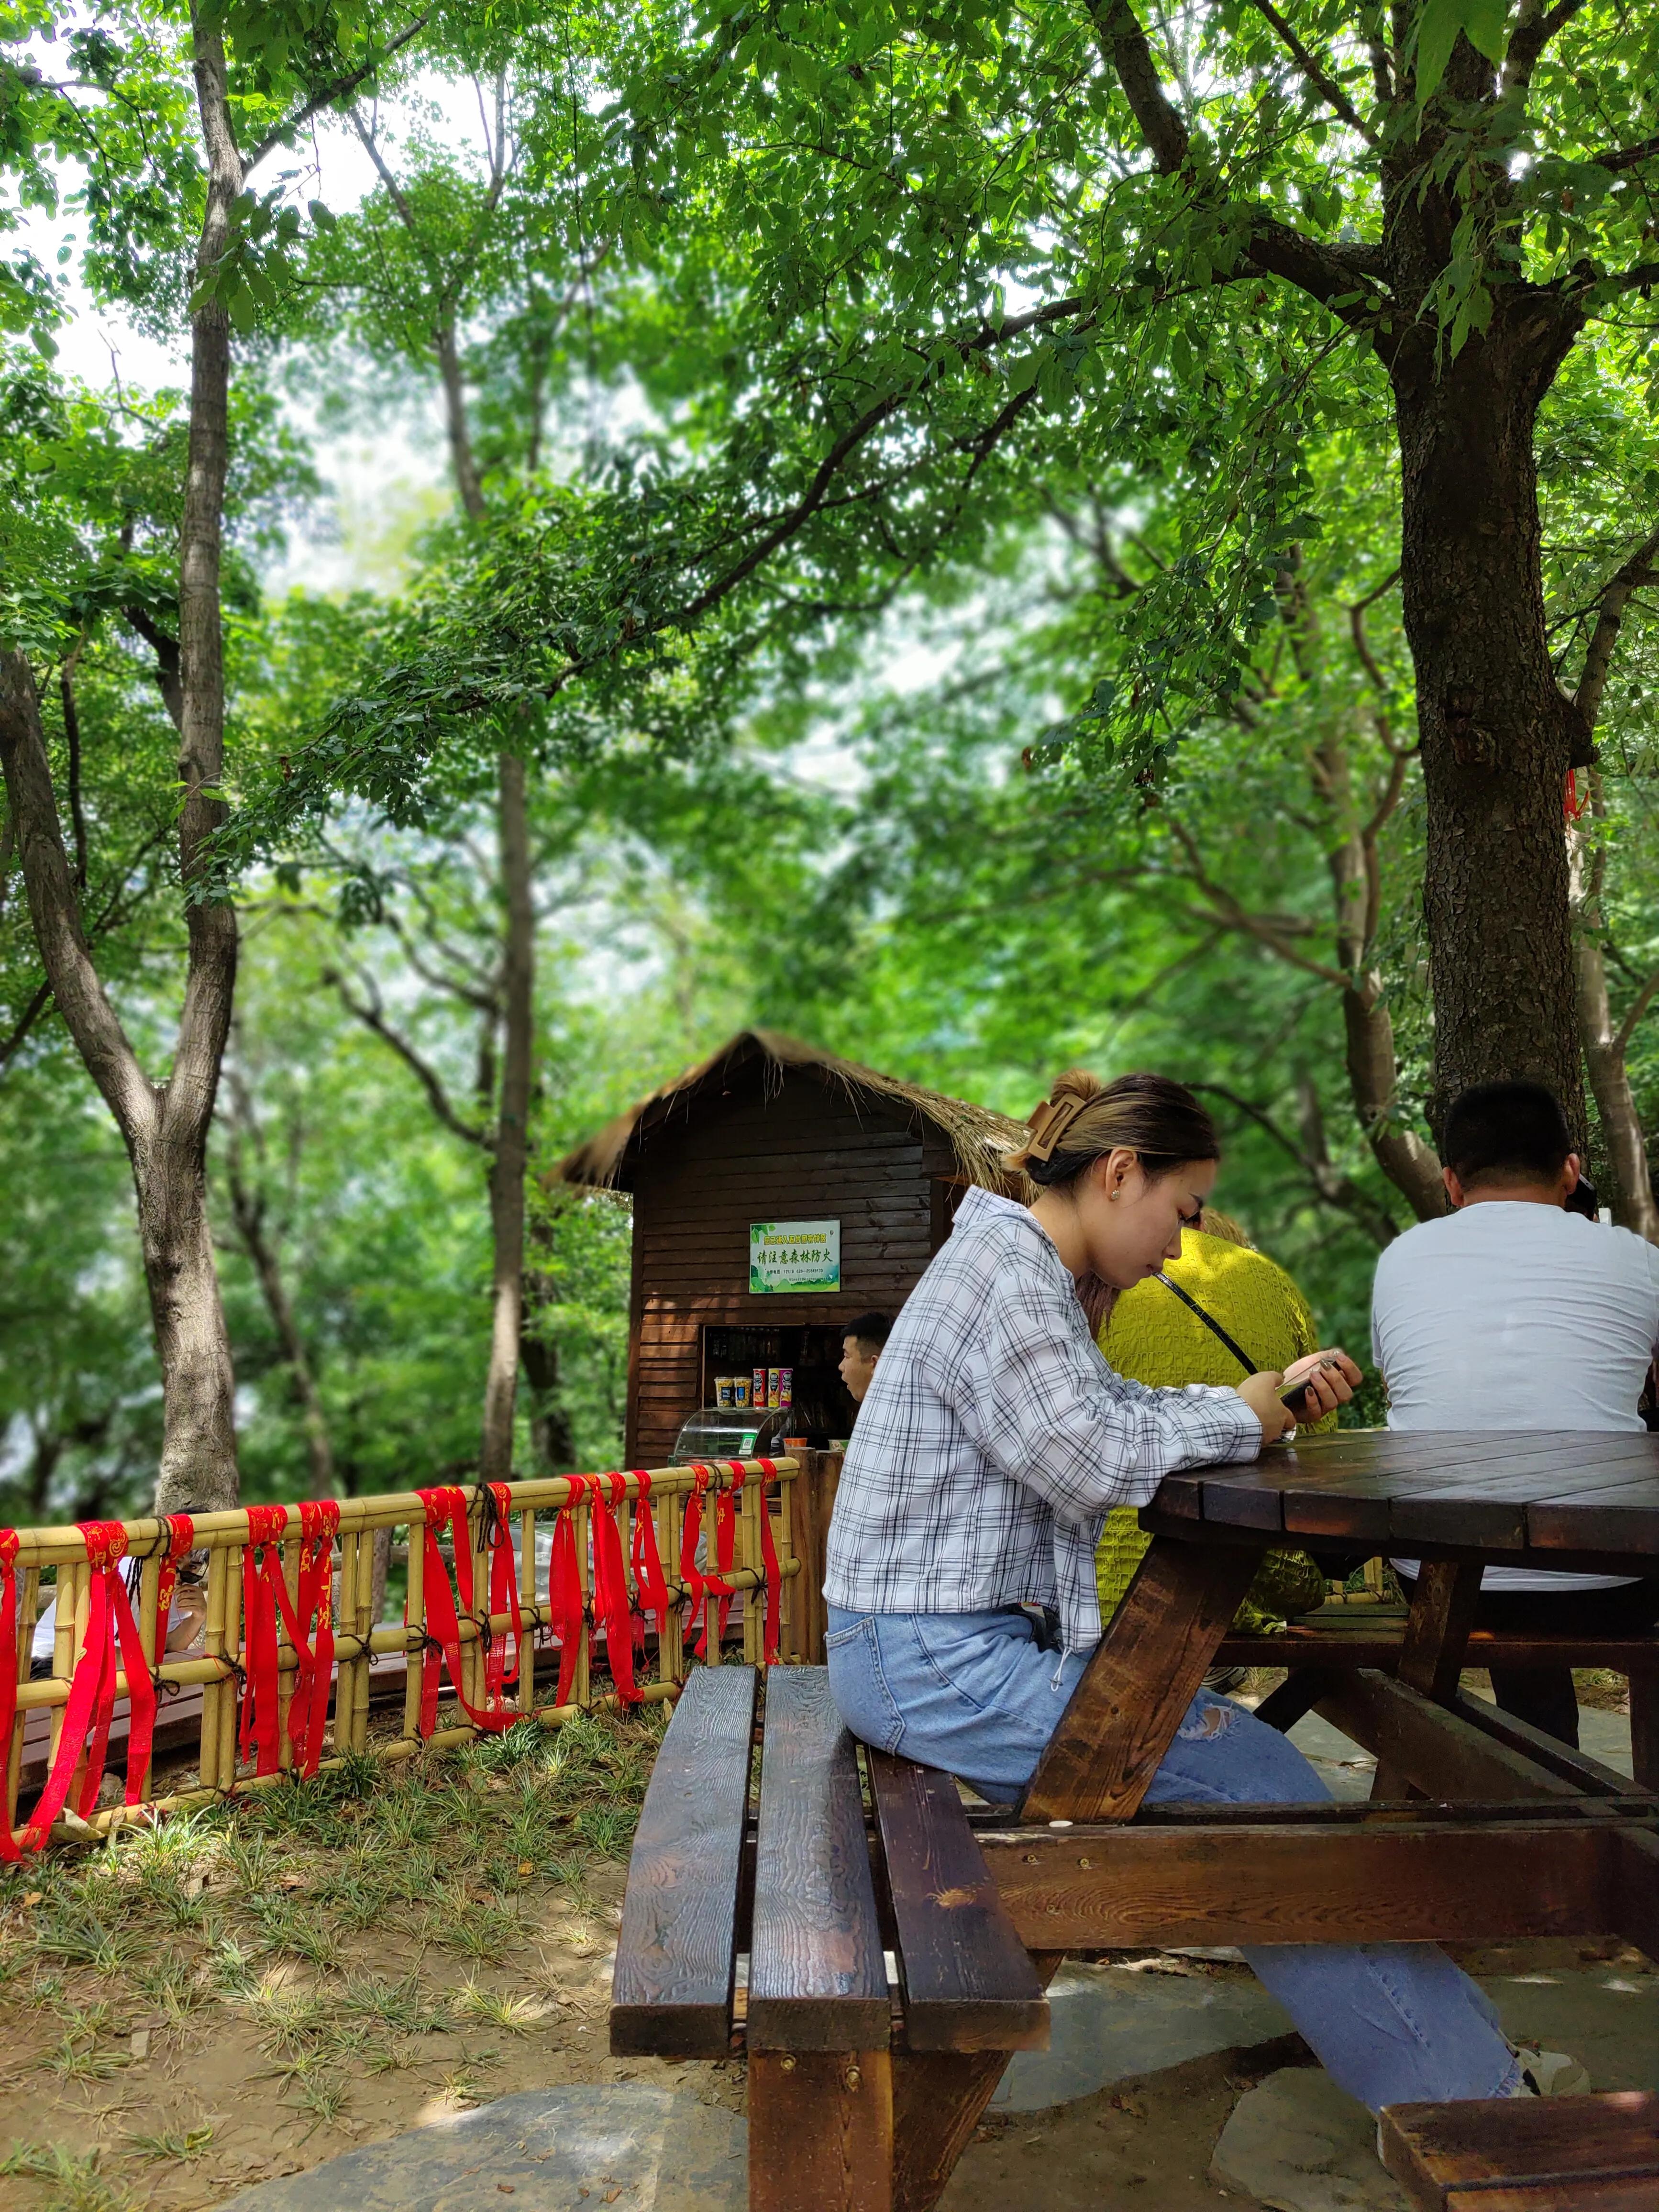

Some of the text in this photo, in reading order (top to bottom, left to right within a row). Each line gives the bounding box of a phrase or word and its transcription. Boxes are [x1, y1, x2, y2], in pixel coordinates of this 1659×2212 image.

[764, 1234, 827, 1245] 您已进入五台国有林区
[757, 1249, 833, 1266] 请注意森林防火
